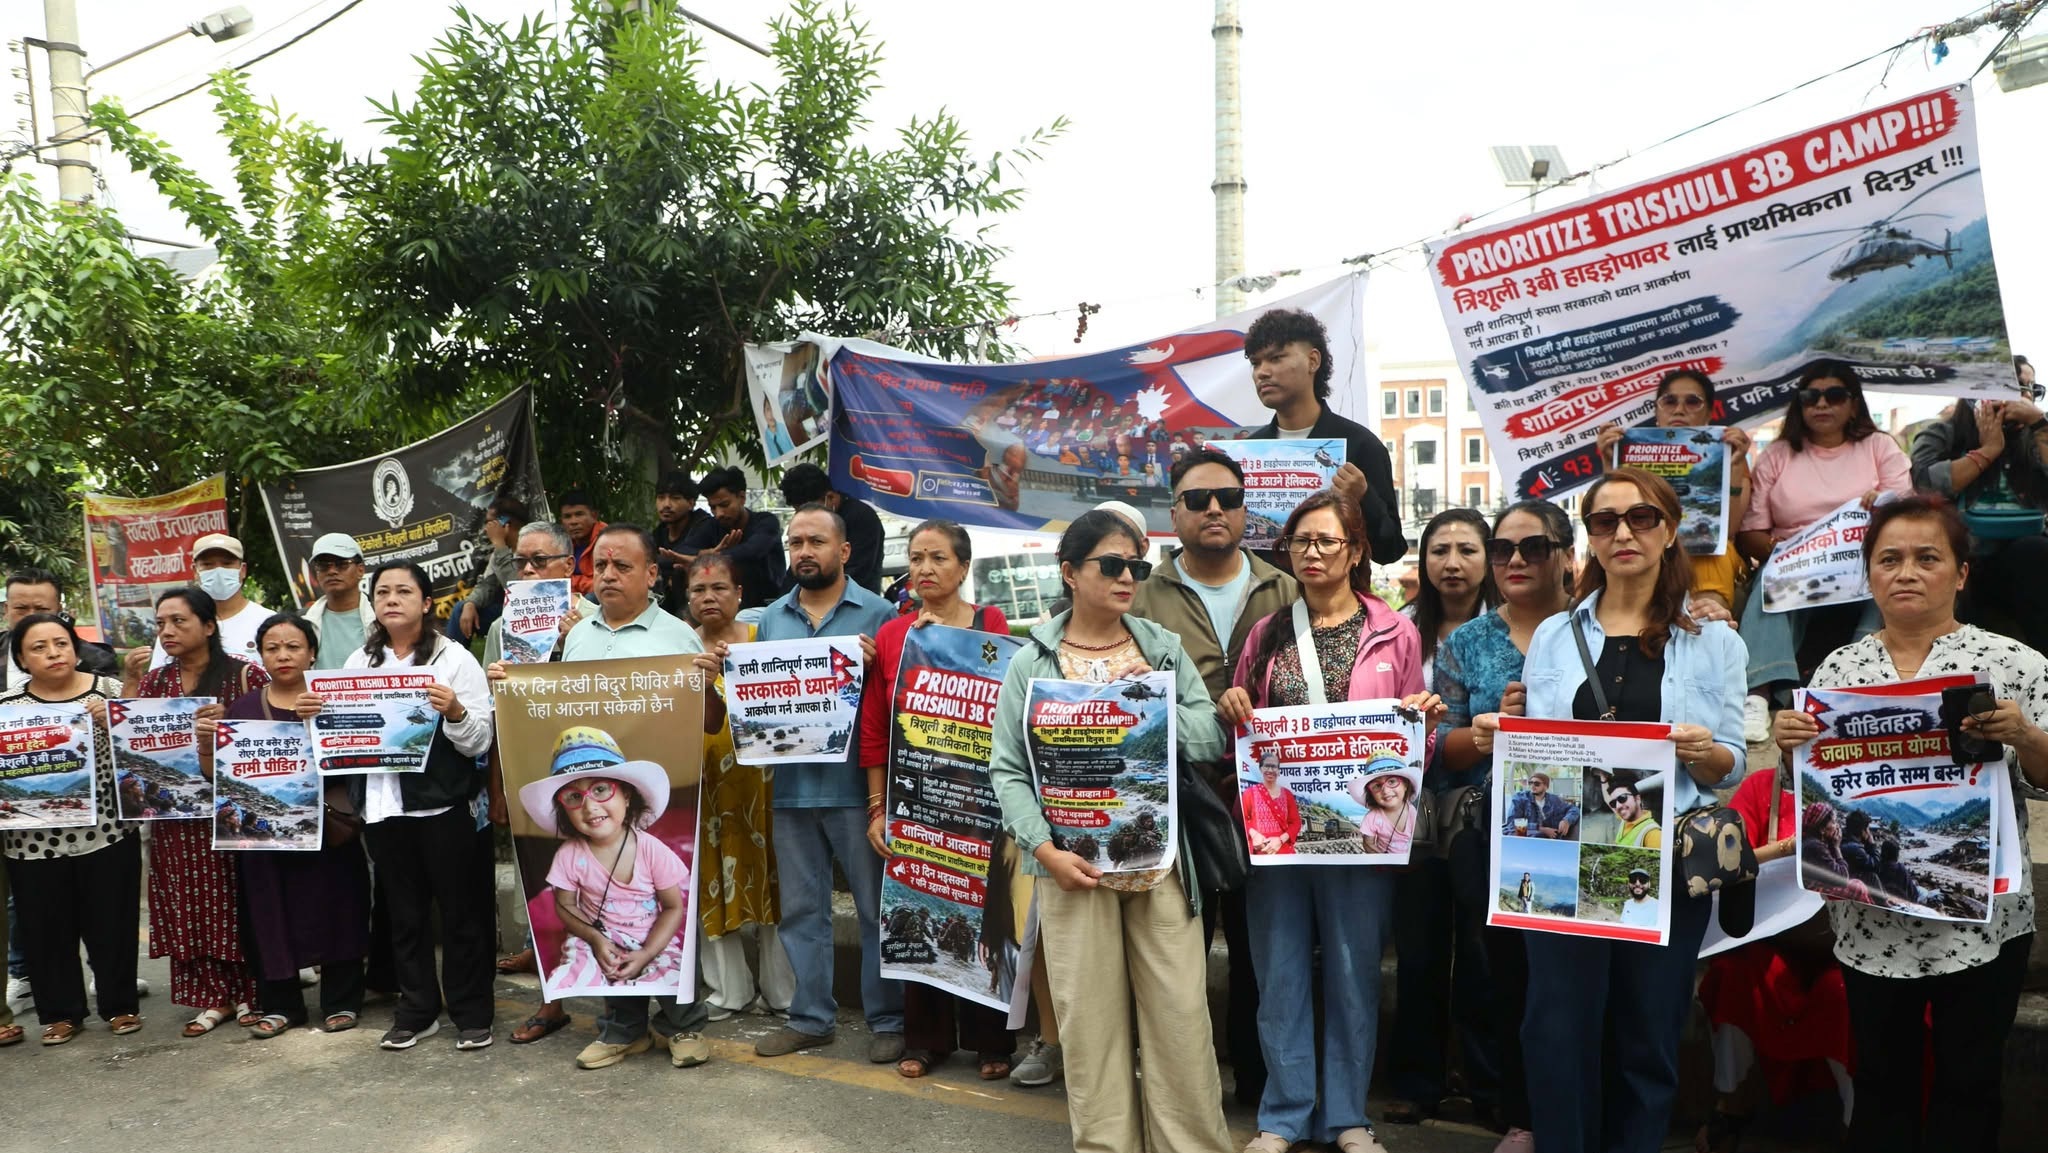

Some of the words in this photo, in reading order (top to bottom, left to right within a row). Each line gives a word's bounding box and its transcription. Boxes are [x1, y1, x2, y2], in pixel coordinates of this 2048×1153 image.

[1451, 213, 1596, 281] PRIORITIZE
[1598, 167, 1738, 236] TRISHULI
[1744, 151, 1794, 195] 3B
[1804, 97, 1945, 174] CAMP!!!
[1453, 277, 1521, 314] त्रिशूली
[1523, 267, 1559, 298] ३बी
[1560, 241, 1671, 289] हाइड्रोपावर
[1674, 224, 1718, 256] लाई
[1721, 186, 1852, 243] प्राथमिकता
[1863, 155, 1938, 197] दिनुस्
[1941, 145, 1964, 168] !!!
[1464, 319, 1485, 338] हामी
[1487, 307, 1534, 334] शान्तिपूर्ण
[1563, 290, 1613, 313] सरकारको
[1615, 285, 1642, 300] ध्यान
[1643, 269, 1692, 293] आकर्षण
[1469, 337, 1484, 351] गर्न
[1486, 329, 1520, 349] आएका
[1522, 324, 1534, 338] हो
[1521, 386, 1608, 433] शान्तिपूर्ण
[1563, 453, 1593, 477] १३
[1741, 382, 1775, 405] पनि
[1517, 442, 1554, 462] त्रिशूली
[1625, 454, 1659, 462] TRISHULI
[1628, 444, 1682, 454] PRIORITIZE
[1256, 459, 1262, 469] B
[1244, 473, 1259, 487] लोड
[1260, 472, 1283, 486] उठाउने
[1285, 473, 1320, 488] हेलिकप्टर
[124, 514, 161, 543] स्वदेशी
[162, 509, 227, 540] उत्पादनमा
[1830, 549, 1860, 562] आएका
[525, 606, 536, 615] दिन
[510, 616, 531, 633] हामी
[533, 615, 556, 629] पीडित
[738, 659, 759, 676] हामी
[761, 655, 802, 675] शान्तिपूर्ण
[804, 656, 828, 670] रुपमा
[315, 679, 354, 691] PRIORITIZE
[356, 677, 389, 688] TRISHULI
[390, 677, 400, 687] 3B
[511, 681, 527, 697] १२
[531, 678, 556, 695] दिन
[561, 675, 590, 695] देखी
[594, 673, 627, 697] बिदुर
[631, 671, 669, 692] शिविर
[674, 668, 684, 688] मै
[688, 672, 702, 691] छु
[735, 674, 802, 701] सरकारको
[805, 676, 839, 696] ध्यान
[914, 670, 1003, 703] PRIORITIZ
[526, 699, 551, 719] तेहा
[555, 701, 599, 717] आउना
[602, 695, 647, 715] सकेको
[649, 692, 674, 713] छैन
[744, 702, 777, 718] आकर्षण
[778, 700, 792, 714] गर्न
[795, 701, 821, 714] आएका
[822, 698, 831, 712] हो
[905, 692, 966, 719] TRISHULI
[969, 703, 984, 721] 3B
[1041, 702, 1110, 715] PRIORITIZE
[128, 714, 144, 725] कति
[146, 714, 157, 724] घर
[159, 713, 175, 723] बसेर
[133, 725, 149, 734] रोएर
[151, 724, 165, 734] दिन
[167, 721, 193, 733] बिताउने
[910, 715, 939, 734] त्रिशूली
[1036, 714, 1078, 725] TRISHULI
[1080, 715, 1093, 725] 3B
[1096, 715, 1134, 725] CAMP!!!
[1251, 716, 1288, 738] त्रिशूली
[1292, 720, 1298, 734] ३
[1302, 718, 1310, 732] B
[1313, 714, 1357, 733] हाइड्रोपावर
[1359, 713, 1395, 726] क्याम्पमा
[129, 735, 156, 751] हामी
[159, 732, 193, 748] पीडित
[234, 738, 250, 749] कति
[252, 738, 264, 748] घर
[266, 737, 282, 747] बसेर
[283, 736, 303, 748] कुरेर,
[926, 735, 970, 753] प्राथमिकता
[1284, 740, 1306, 759] लोड
[1310, 734, 1346, 756] उठाउने
[1820, 743, 1863, 763] जवाफ
[1867, 741, 1903, 758] पाउन
[1907, 734, 1941, 755] योग्य
[238, 749, 255, 759] रोएर
[257, 748, 272, 758] दिन
[273, 748, 299, 757] बिताउने
[232, 760, 260, 777] हामी
[263, 758, 297, 774] पीडित
[300, 760, 307, 772] ?
[1324, 764, 1354, 779] उपयुक्त
[1290, 780, 1331, 793] पठाइदिन
[1831, 768, 1862, 797] कुरेर
[1865, 763, 1895, 787] कति
[1899, 766, 1930, 784] सम्म
[1969, 761, 1984, 786] ?
[901, 823, 945, 848] शान्तिपूर्ण
[946, 837, 979, 856] आव्हान
[981, 845, 991, 858] !!!
[910, 863, 920, 876] १३
[922, 863, 935, 879] दिन
